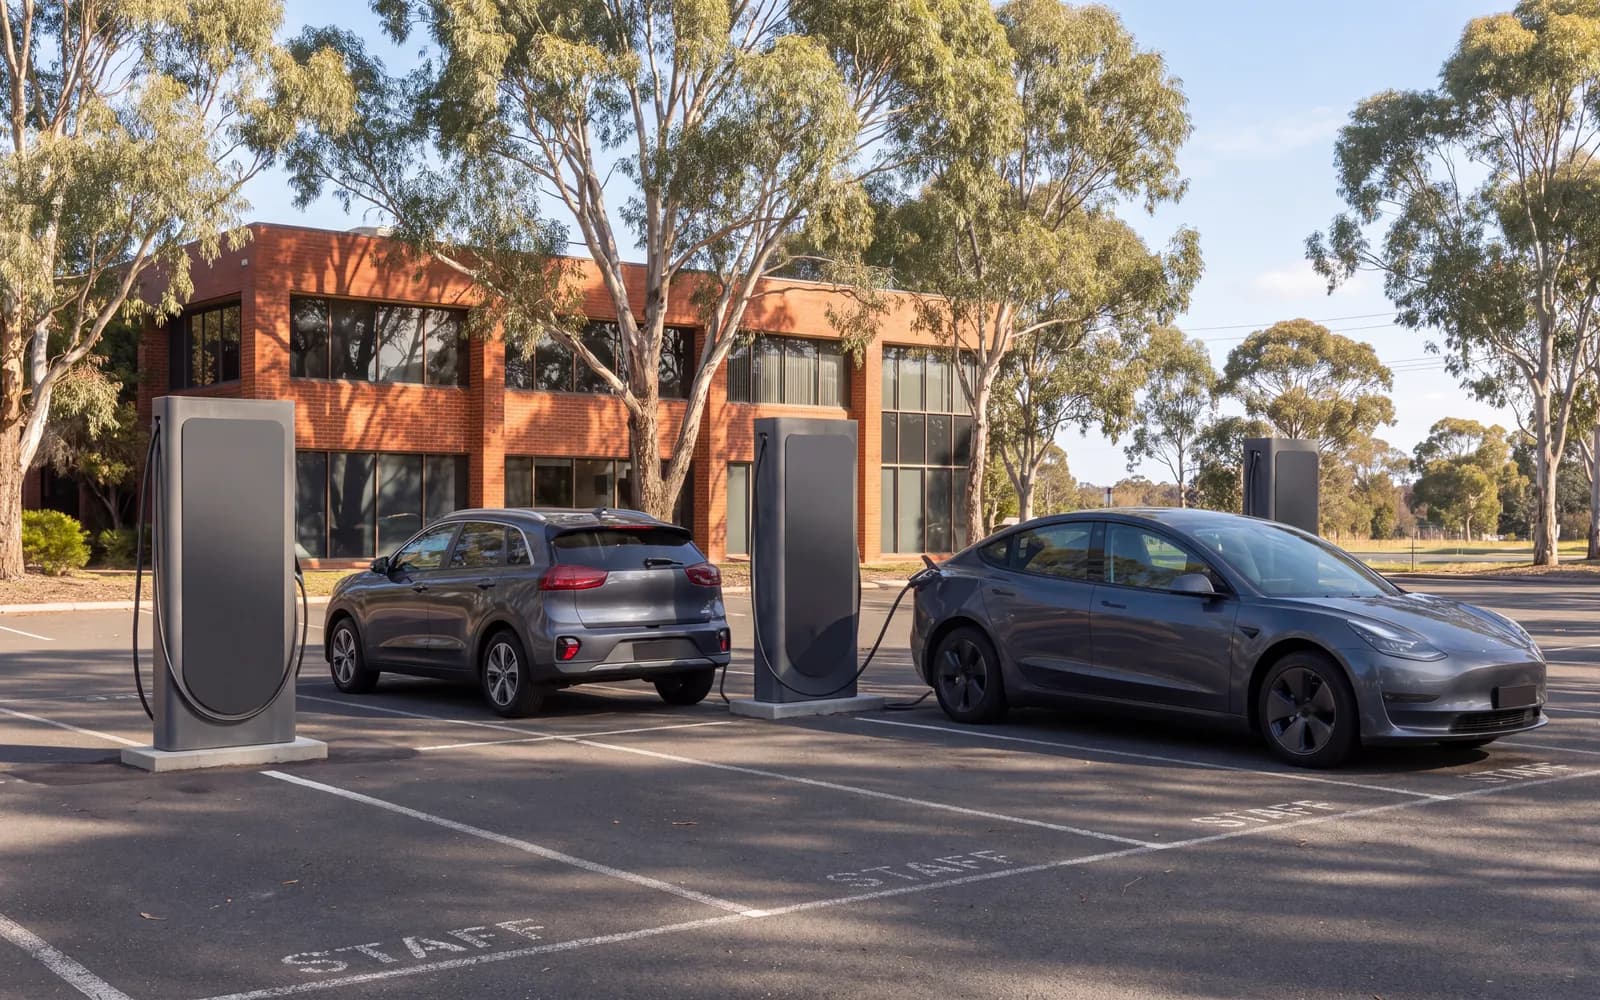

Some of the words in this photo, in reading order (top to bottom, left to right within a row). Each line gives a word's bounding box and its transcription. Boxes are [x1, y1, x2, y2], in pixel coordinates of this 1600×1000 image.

[1456, 762, 1571, 783] STAFF
[1191, 800, 1334, 827] STAFF
[827, 850, 1013, 886] STAFF
[281, 918, 544, 973] STAFF
